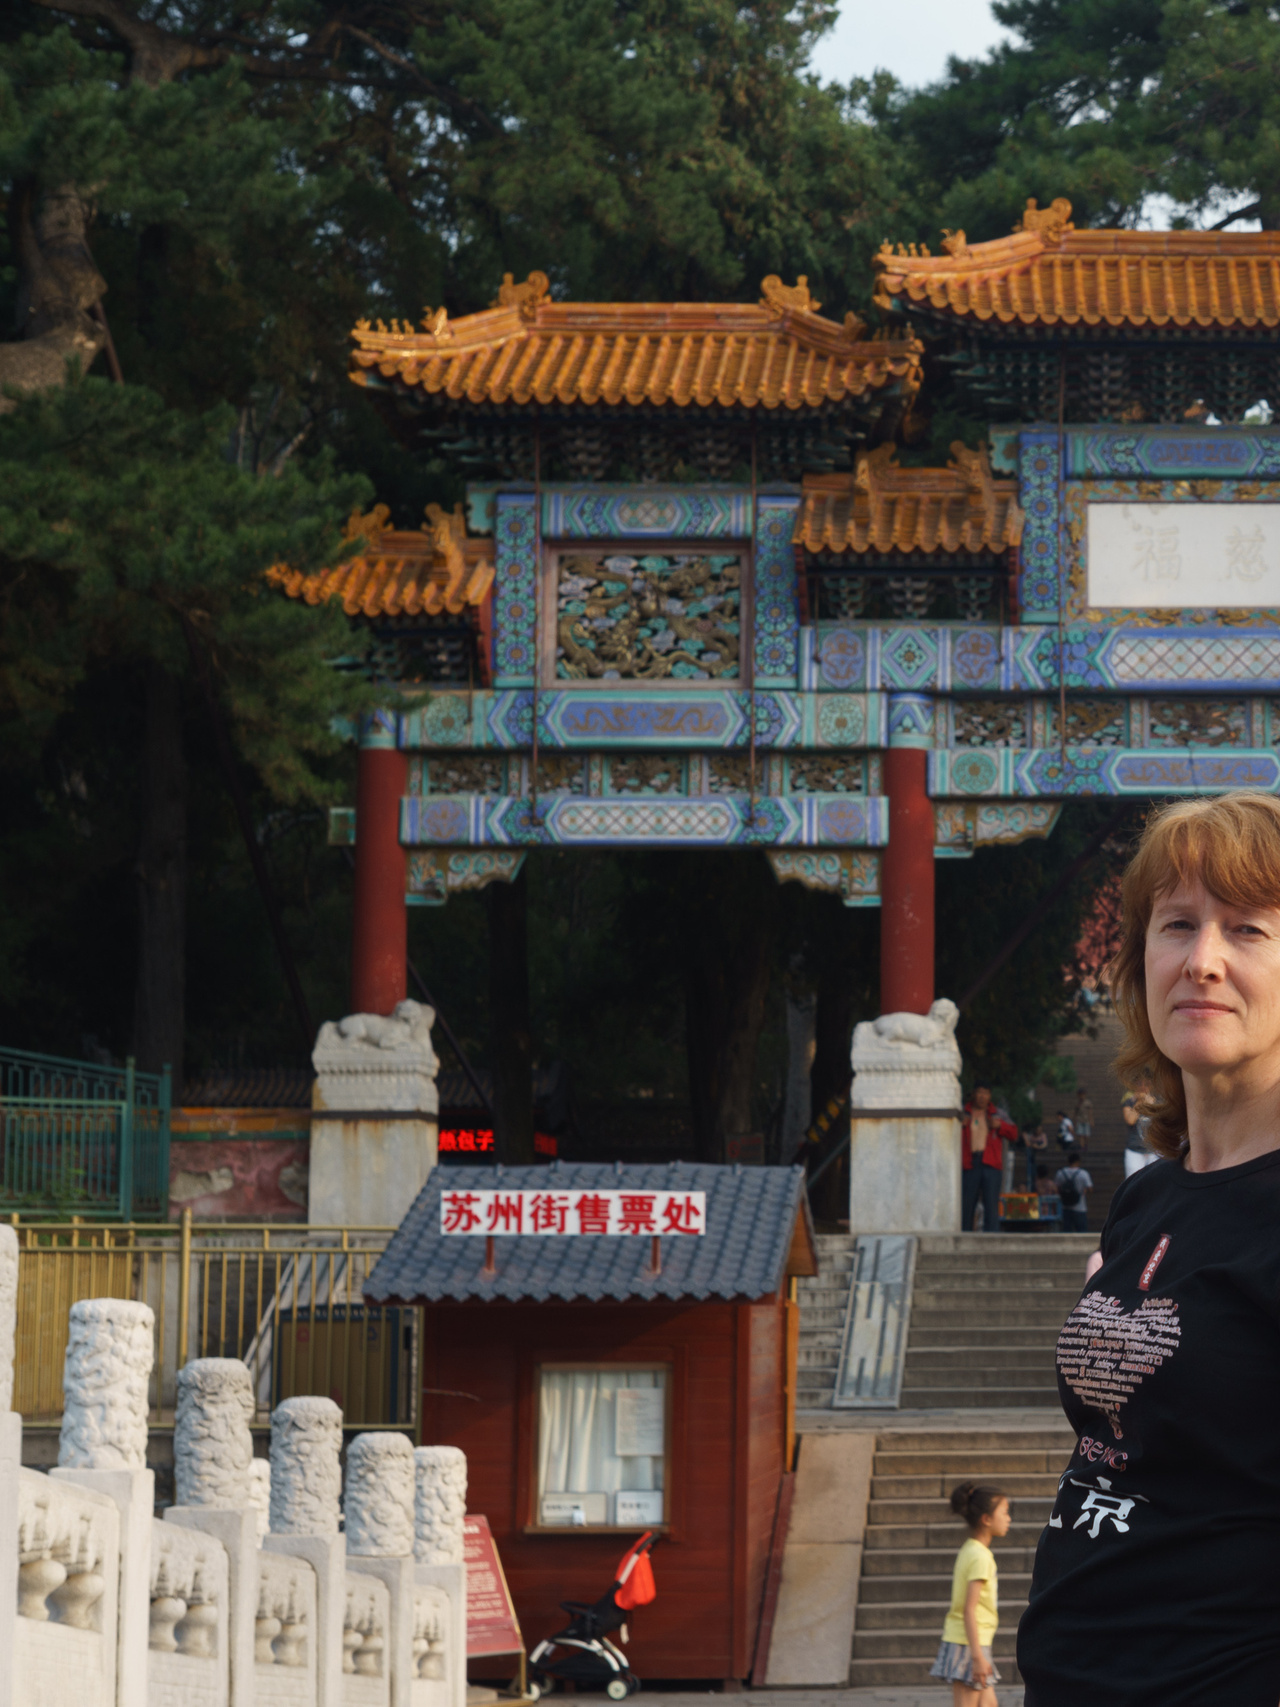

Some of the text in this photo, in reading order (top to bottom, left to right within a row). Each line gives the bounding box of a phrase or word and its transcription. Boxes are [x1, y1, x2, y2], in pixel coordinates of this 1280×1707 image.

[442, 1192, 701, 1235] 苏州街售票处
